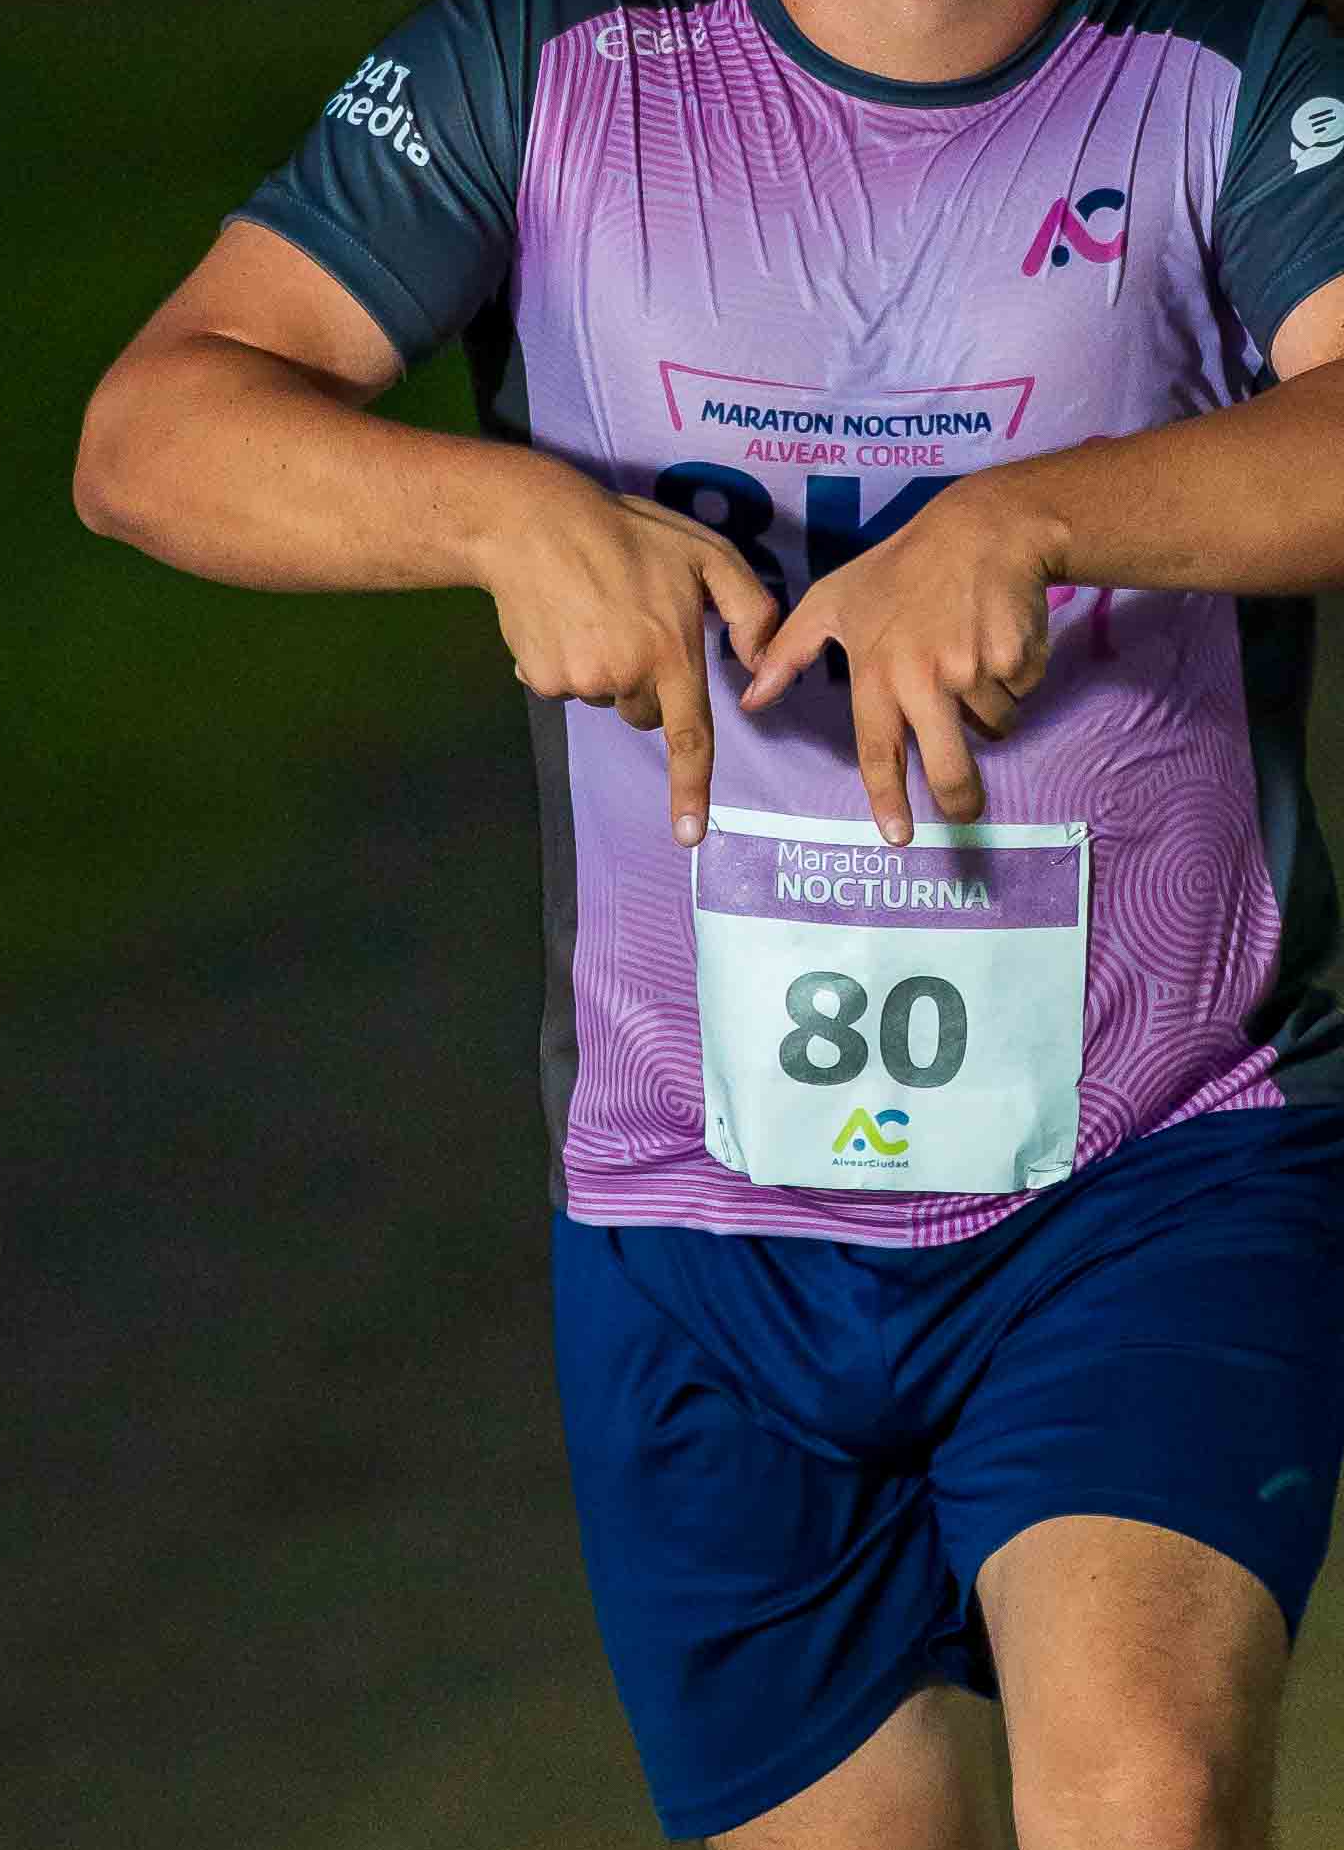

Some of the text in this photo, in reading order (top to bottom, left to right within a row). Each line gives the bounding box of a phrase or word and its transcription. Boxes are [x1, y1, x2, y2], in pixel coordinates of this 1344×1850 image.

[701, 400, 992, 438] MARATON NOCTURNA
[744, 438, 945, 467] ALVEAR CORRE
[777, 841, 903, 875] Maratón
[776, 871, 992, 911] NOCTURNA
[779, 970, 968, 1089] 80
